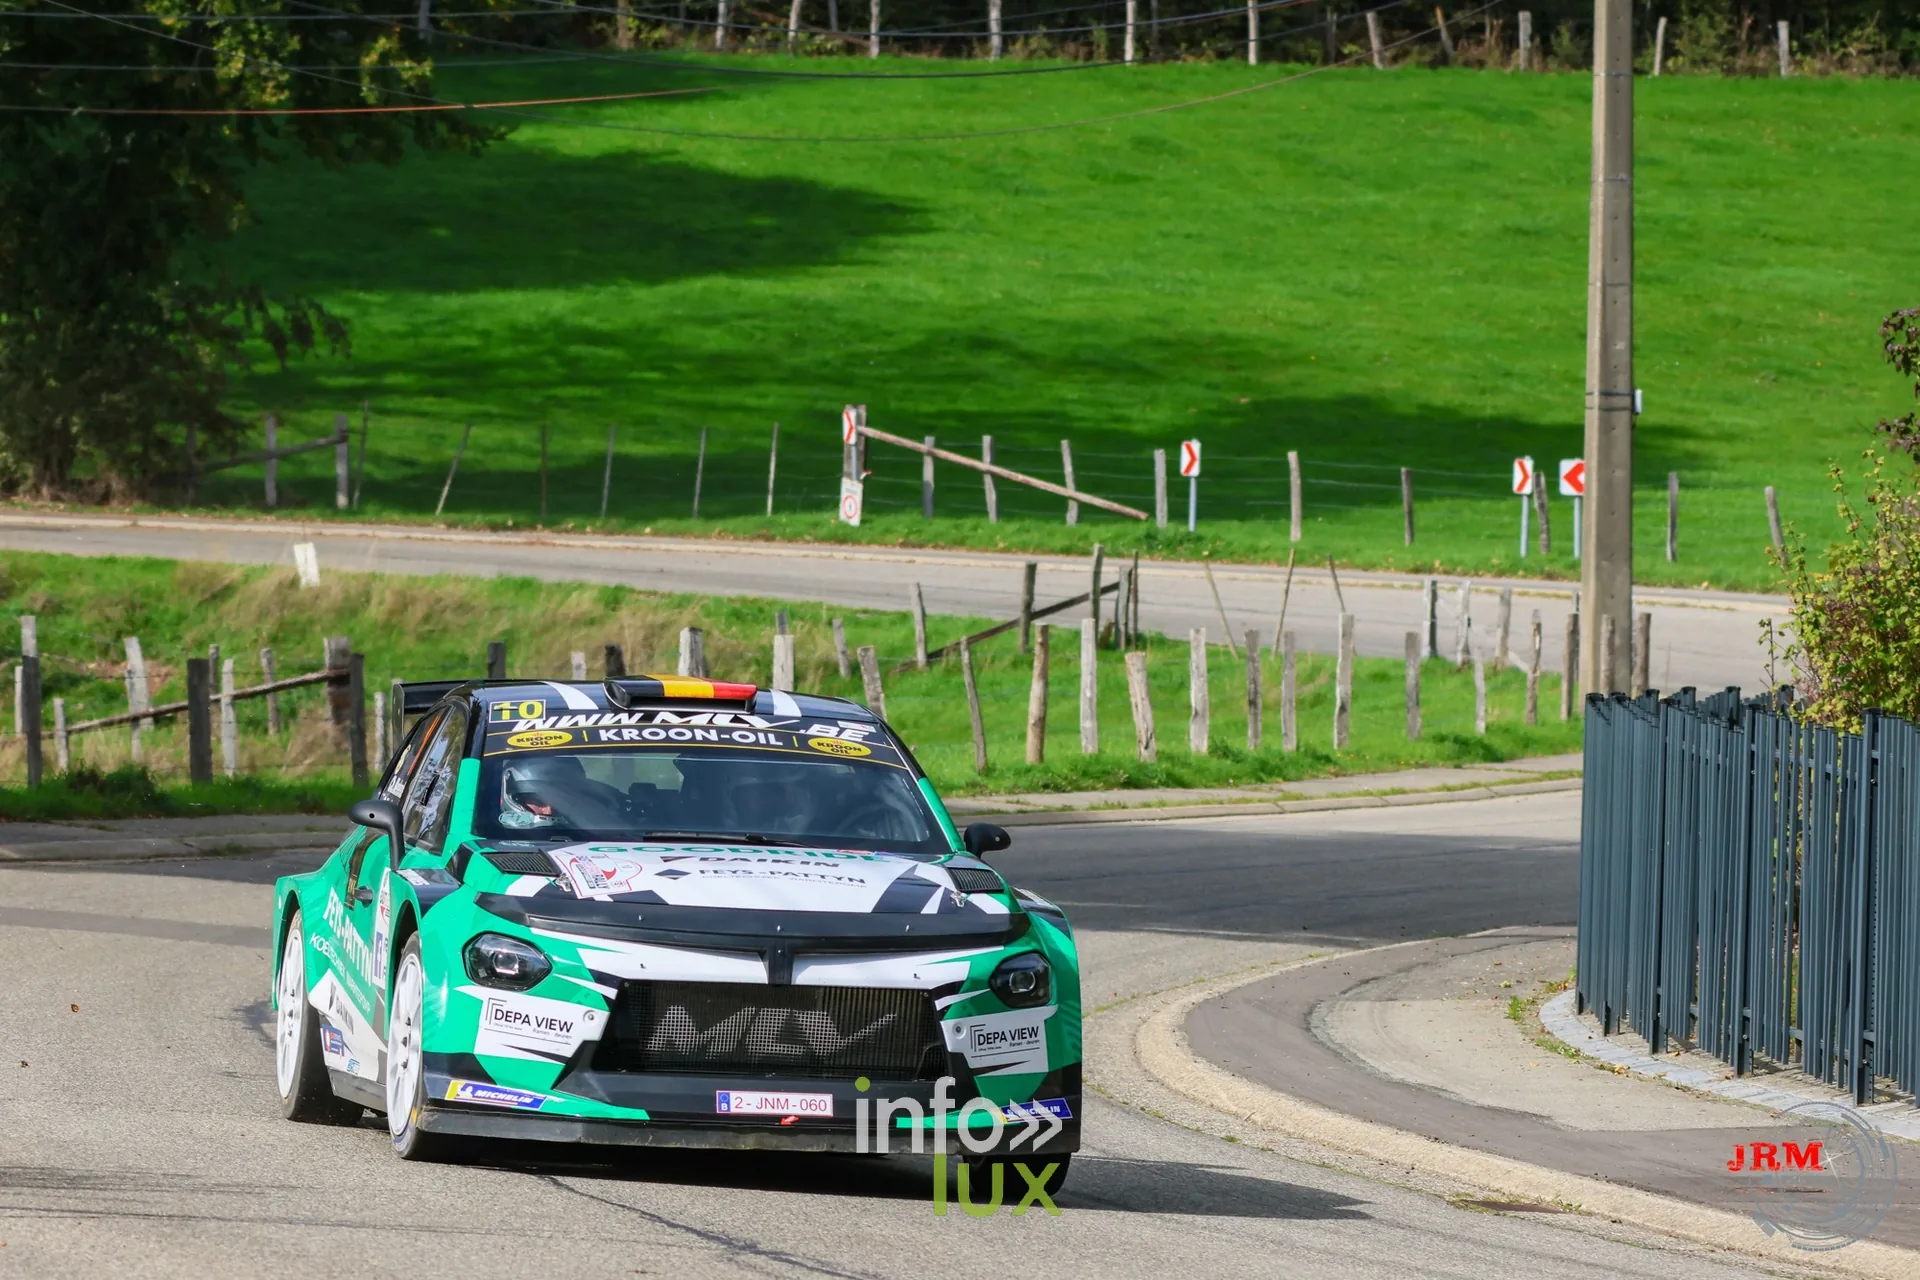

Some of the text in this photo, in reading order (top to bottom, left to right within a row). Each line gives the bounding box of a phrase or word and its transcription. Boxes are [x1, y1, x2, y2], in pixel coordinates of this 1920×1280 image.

[493, 701, 543, 720] 10
[516, 734, 563, 744] KROON
[599, 728, 783, 746] KROON-OIL
[816, 741, 862, 752] KROON
[830, 747, 851, 755] OIL
[587, 846, 890, 862] GOODRIDE
[698, 857, 840, 868] DAIKIN
[494, 1008, 531, 1026] DEPA
[535, 1015, 573, 1033] VIEW
[977, 1026, 1040, 1046] DEPA VIEW
[474, 1090, 534, 1104] MICHELIN
[721, 1103, 729, 1111] B
